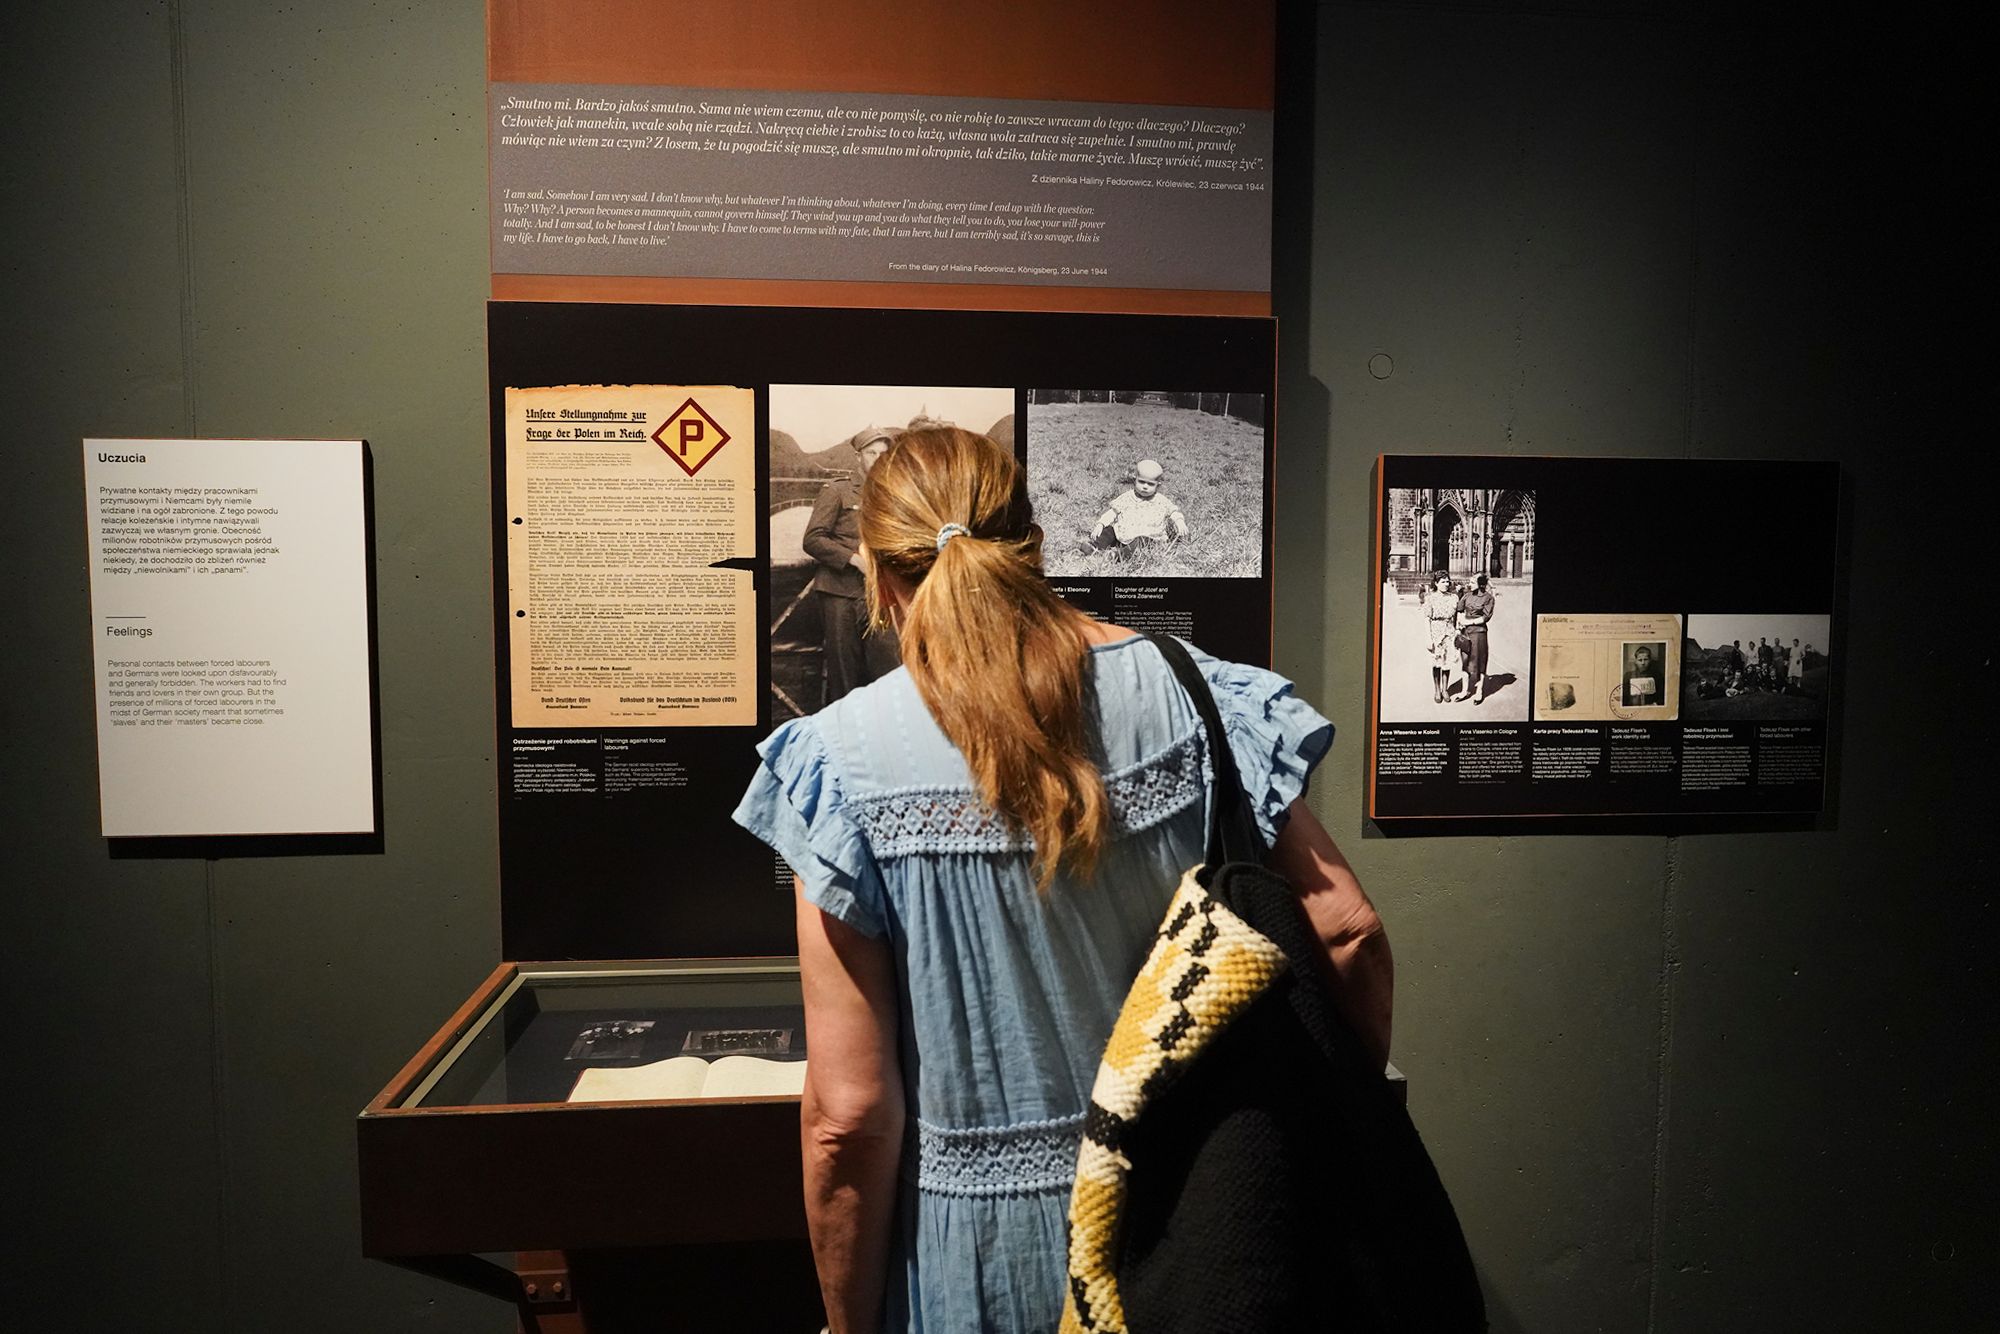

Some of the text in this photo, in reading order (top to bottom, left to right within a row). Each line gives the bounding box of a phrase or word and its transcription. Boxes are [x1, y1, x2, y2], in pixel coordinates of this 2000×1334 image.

[553, 97, 571, 111] mi.
[574, 97, 616, 112] Bardzo
[615, 98, 649, 117] jakoś
[650, 99, 696, 114] smutno.
[698, 101, 731, 115] Sama
[733, 102, 752, 116] nie
[753, 102, 783, 117] wiem
[785, 107, 824, 122] czemu,
[826, 104, 844, 119] ale
[845, 109, 859, 119] co
[860, 105, 878, 120] nie
[878, 106, 927, 126] pomyślę,
[929, 112, 943, 122] co
[944, 109, 962, 123] nie
[963, 110, 993, 129] robię
[994, 111, 1005, 125] to
[1006, 115, 1046, 127] zawsze
[1047, 117, 1091, 129] wracam
[1092, 115, 1106, 129] do
[1108, 116, 1134, 134] tego:
[1136, 117, 1190, 136] dlaczego?
[1190, 119, 1246, 138] Dlaczego?
[501, 114, 554, 129] Człowiek
[552, 115, 574, 133] jak
[576, 115, 629, 134] manekin,
[631, 116, 665, 131] wcale
[665, 117, 693, 136] sobą
[694, 118, 713, 132] nie
[714, 119, 753, 138] rządzi.
[755, 120, 804, 139] Nakręcą
[805, 121, 839, 136] ciebie
[846, 123, 887, 138] zrobisz
[888, 124, 900, 138] to
[901, 128, 915, 139] co
[916, 125, 945, 144] każą,
[948, 127, 988, 142] własna
[990, 128, 1016, 143] wola
[1017, 129, 1059, 145] zatraca
[1060, 131, 1077, 150] się
[1077, 132, 1126, 151] zupełnie.
[1129, 134, 1135, 148] I
[1135, 134, 1176, 149] smutno
[1177, 136, 1194, 154] mi,
[1195, 136, 1236, 156] prawdę
[1031, 174, 1264, 191] Z dziennika Haliny Fedorowicz, Królewiec, 23 czerwca 1944
[503, 235, 517, 246] my
[518, 232, 535, 243] life.
[541, 232, 564, 244] have
[564, 233, 574, 244] to
[573, 236, 586, 247] go
[586, 233, 610, 248] back,
[617, 234, 639, 245] have
[639, 234, 649, 245] to
[888, 261, 1107, 276] From the diary of Halina Fedorowicz, Königsberg, 23 June 1944
[526, 409, 646, 420] Unsere Stellungnahme zur
[526, 428, 646, 440] Frage der Polen im Reich.
[680, 419, 704, 456] P
[98, 452, 146, 463] Uczucia
[106, 626, 152, 639] Feelings
